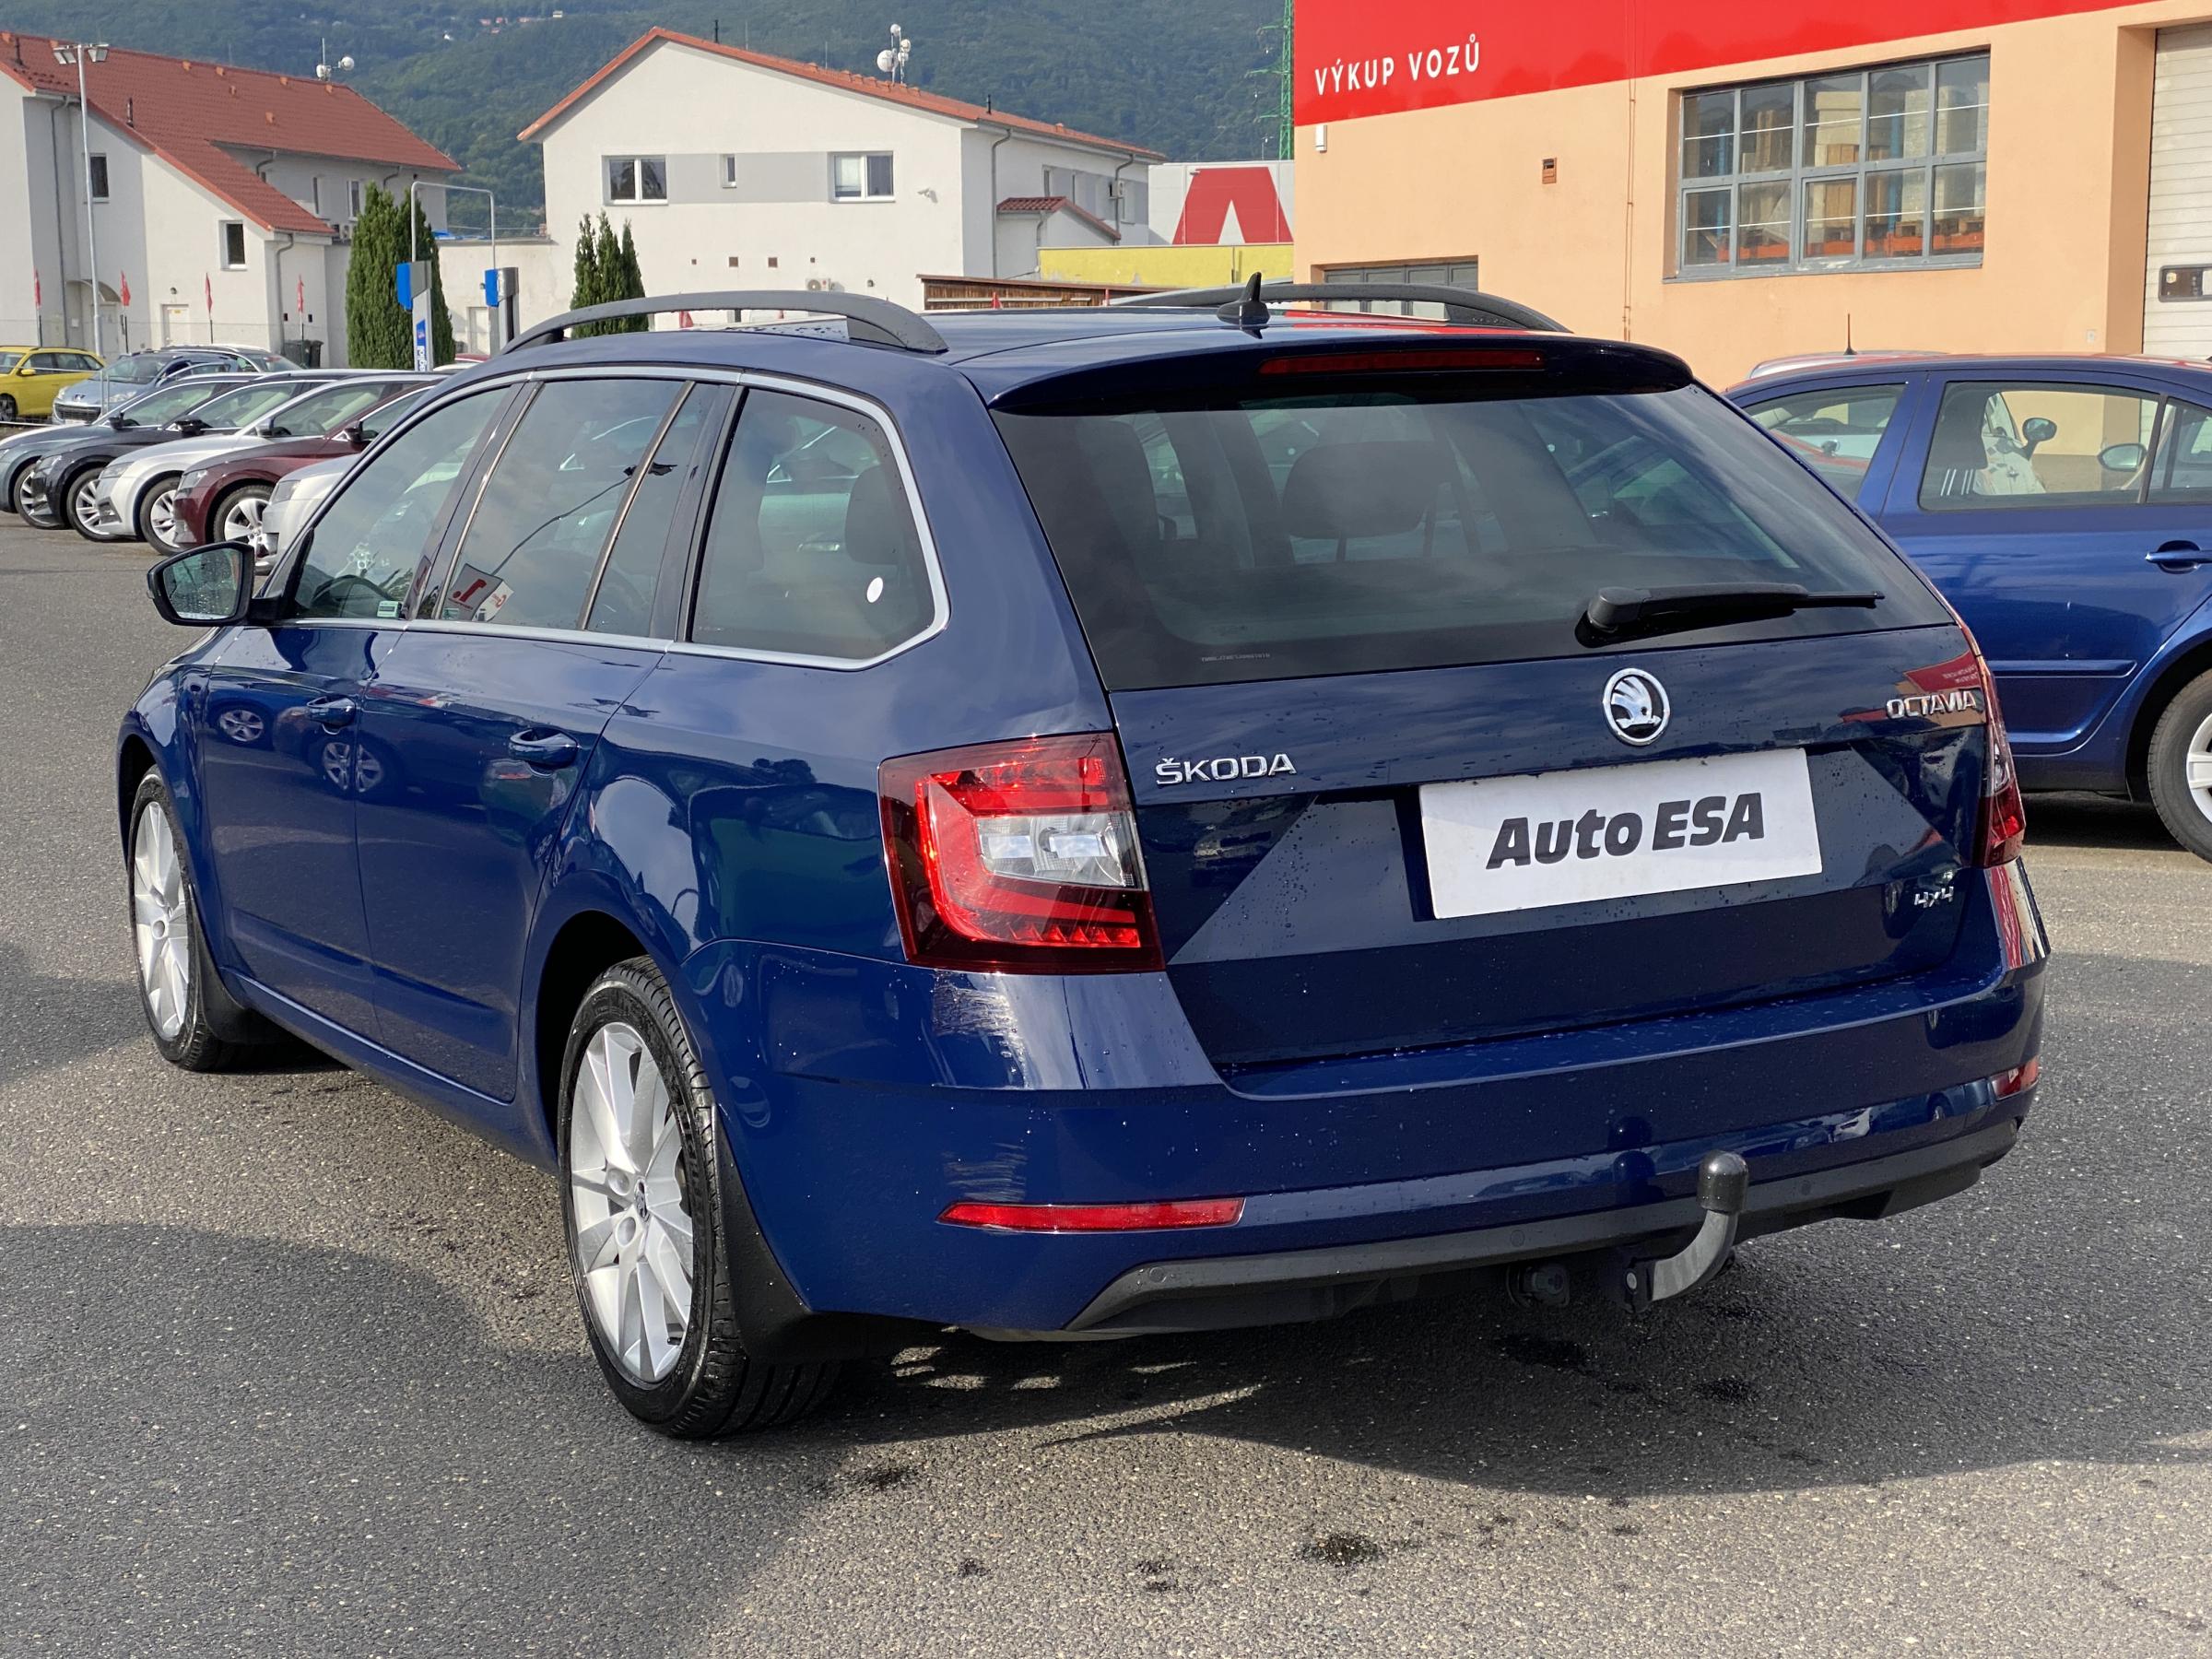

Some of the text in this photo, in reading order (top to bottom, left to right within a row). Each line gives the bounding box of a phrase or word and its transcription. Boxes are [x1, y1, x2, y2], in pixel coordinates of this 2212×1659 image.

[1315, 33, 1479, 96] VÝKUP VOZŮ
[1886, 690, 1977, 719] OCTAVIA
[1155, 753, 1297, 784] ŠKODA
[1486, 793, 1764, 869] Auto ESA
[1914, 887, 1954, 908] 4x4
